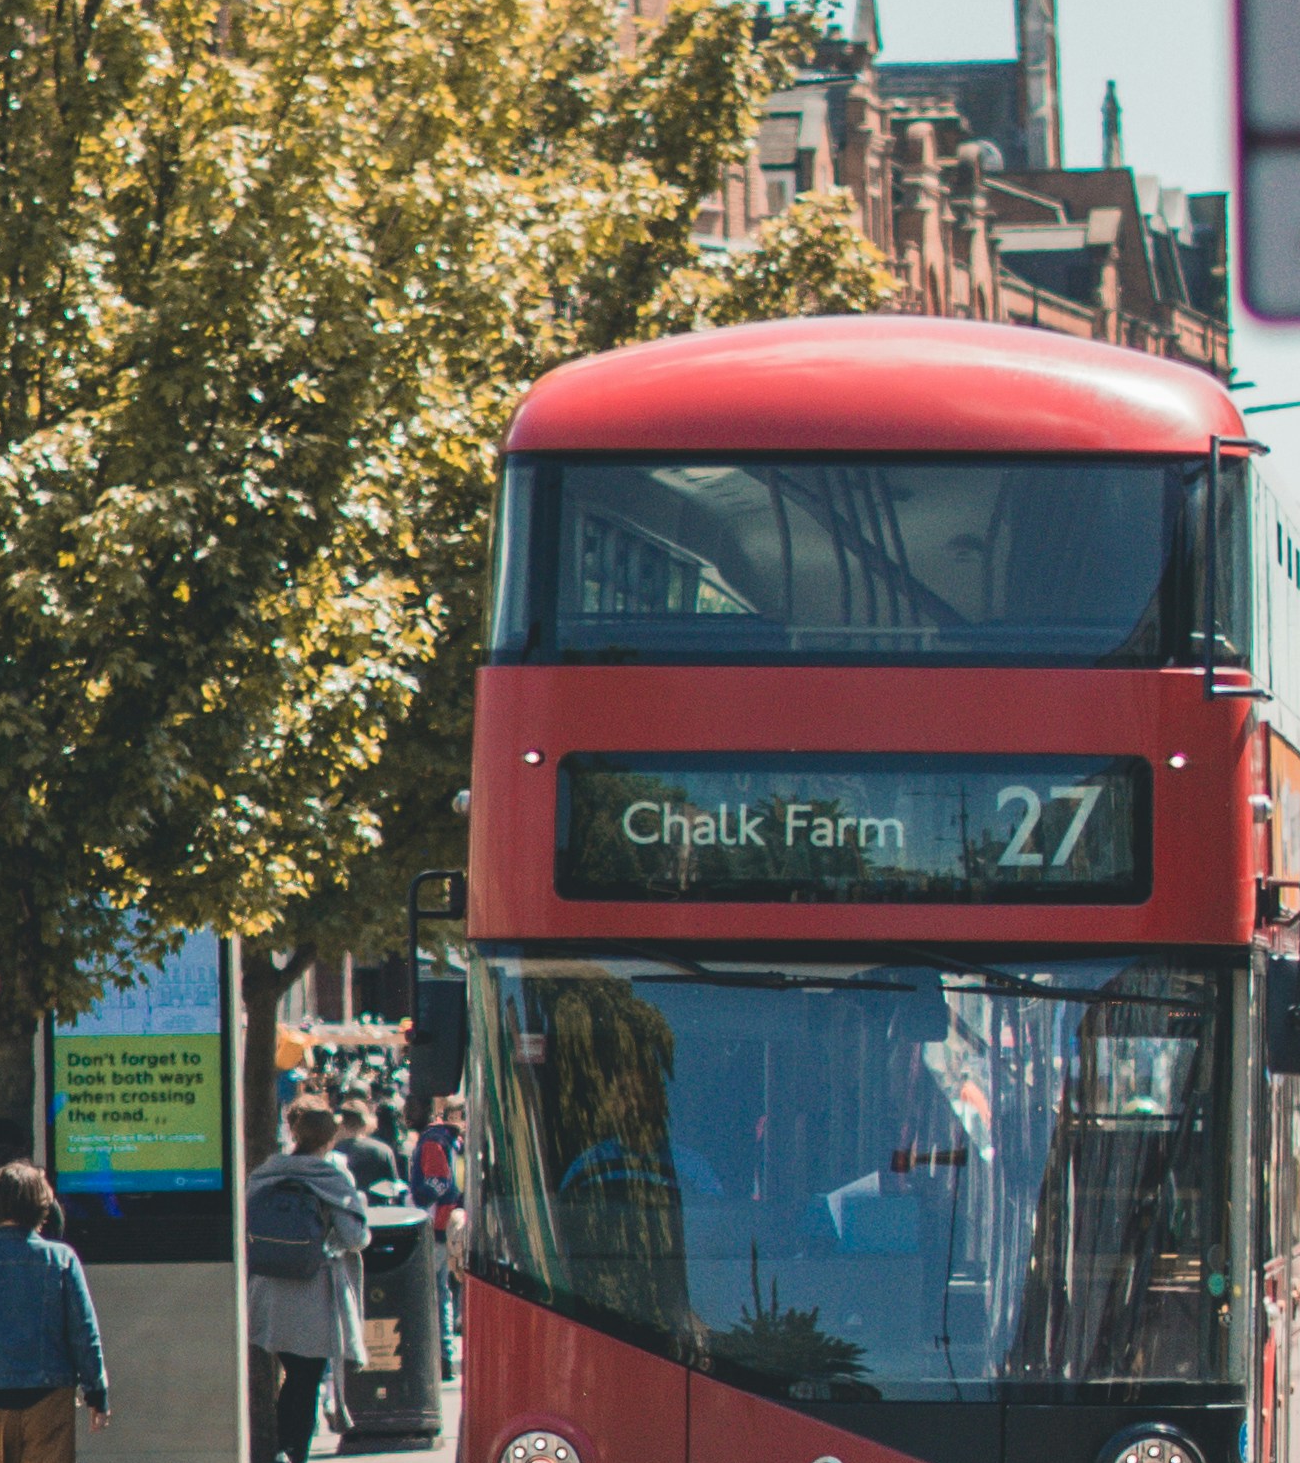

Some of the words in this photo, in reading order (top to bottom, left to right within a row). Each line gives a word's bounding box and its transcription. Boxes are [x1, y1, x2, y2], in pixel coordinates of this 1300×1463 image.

[622, 802, 765, 847] Chalk
[785, 803, 905, 848] Farm
[996, 784, 1103, 867] 27
[67, 1052, 115, 1067] Don't
[121, 1051, 176, 1068] forget
[182, 1052, 202, 1065] to
[67, 1071, 105, 1085] look
[112, 1070, 153, 1085] both
[159, 1073, 204, 1086] ways
[68, 1091, 115, 1104] when
[121, 1090, 196, 1105] crossing
[67, 1109, 97, 1122] the
